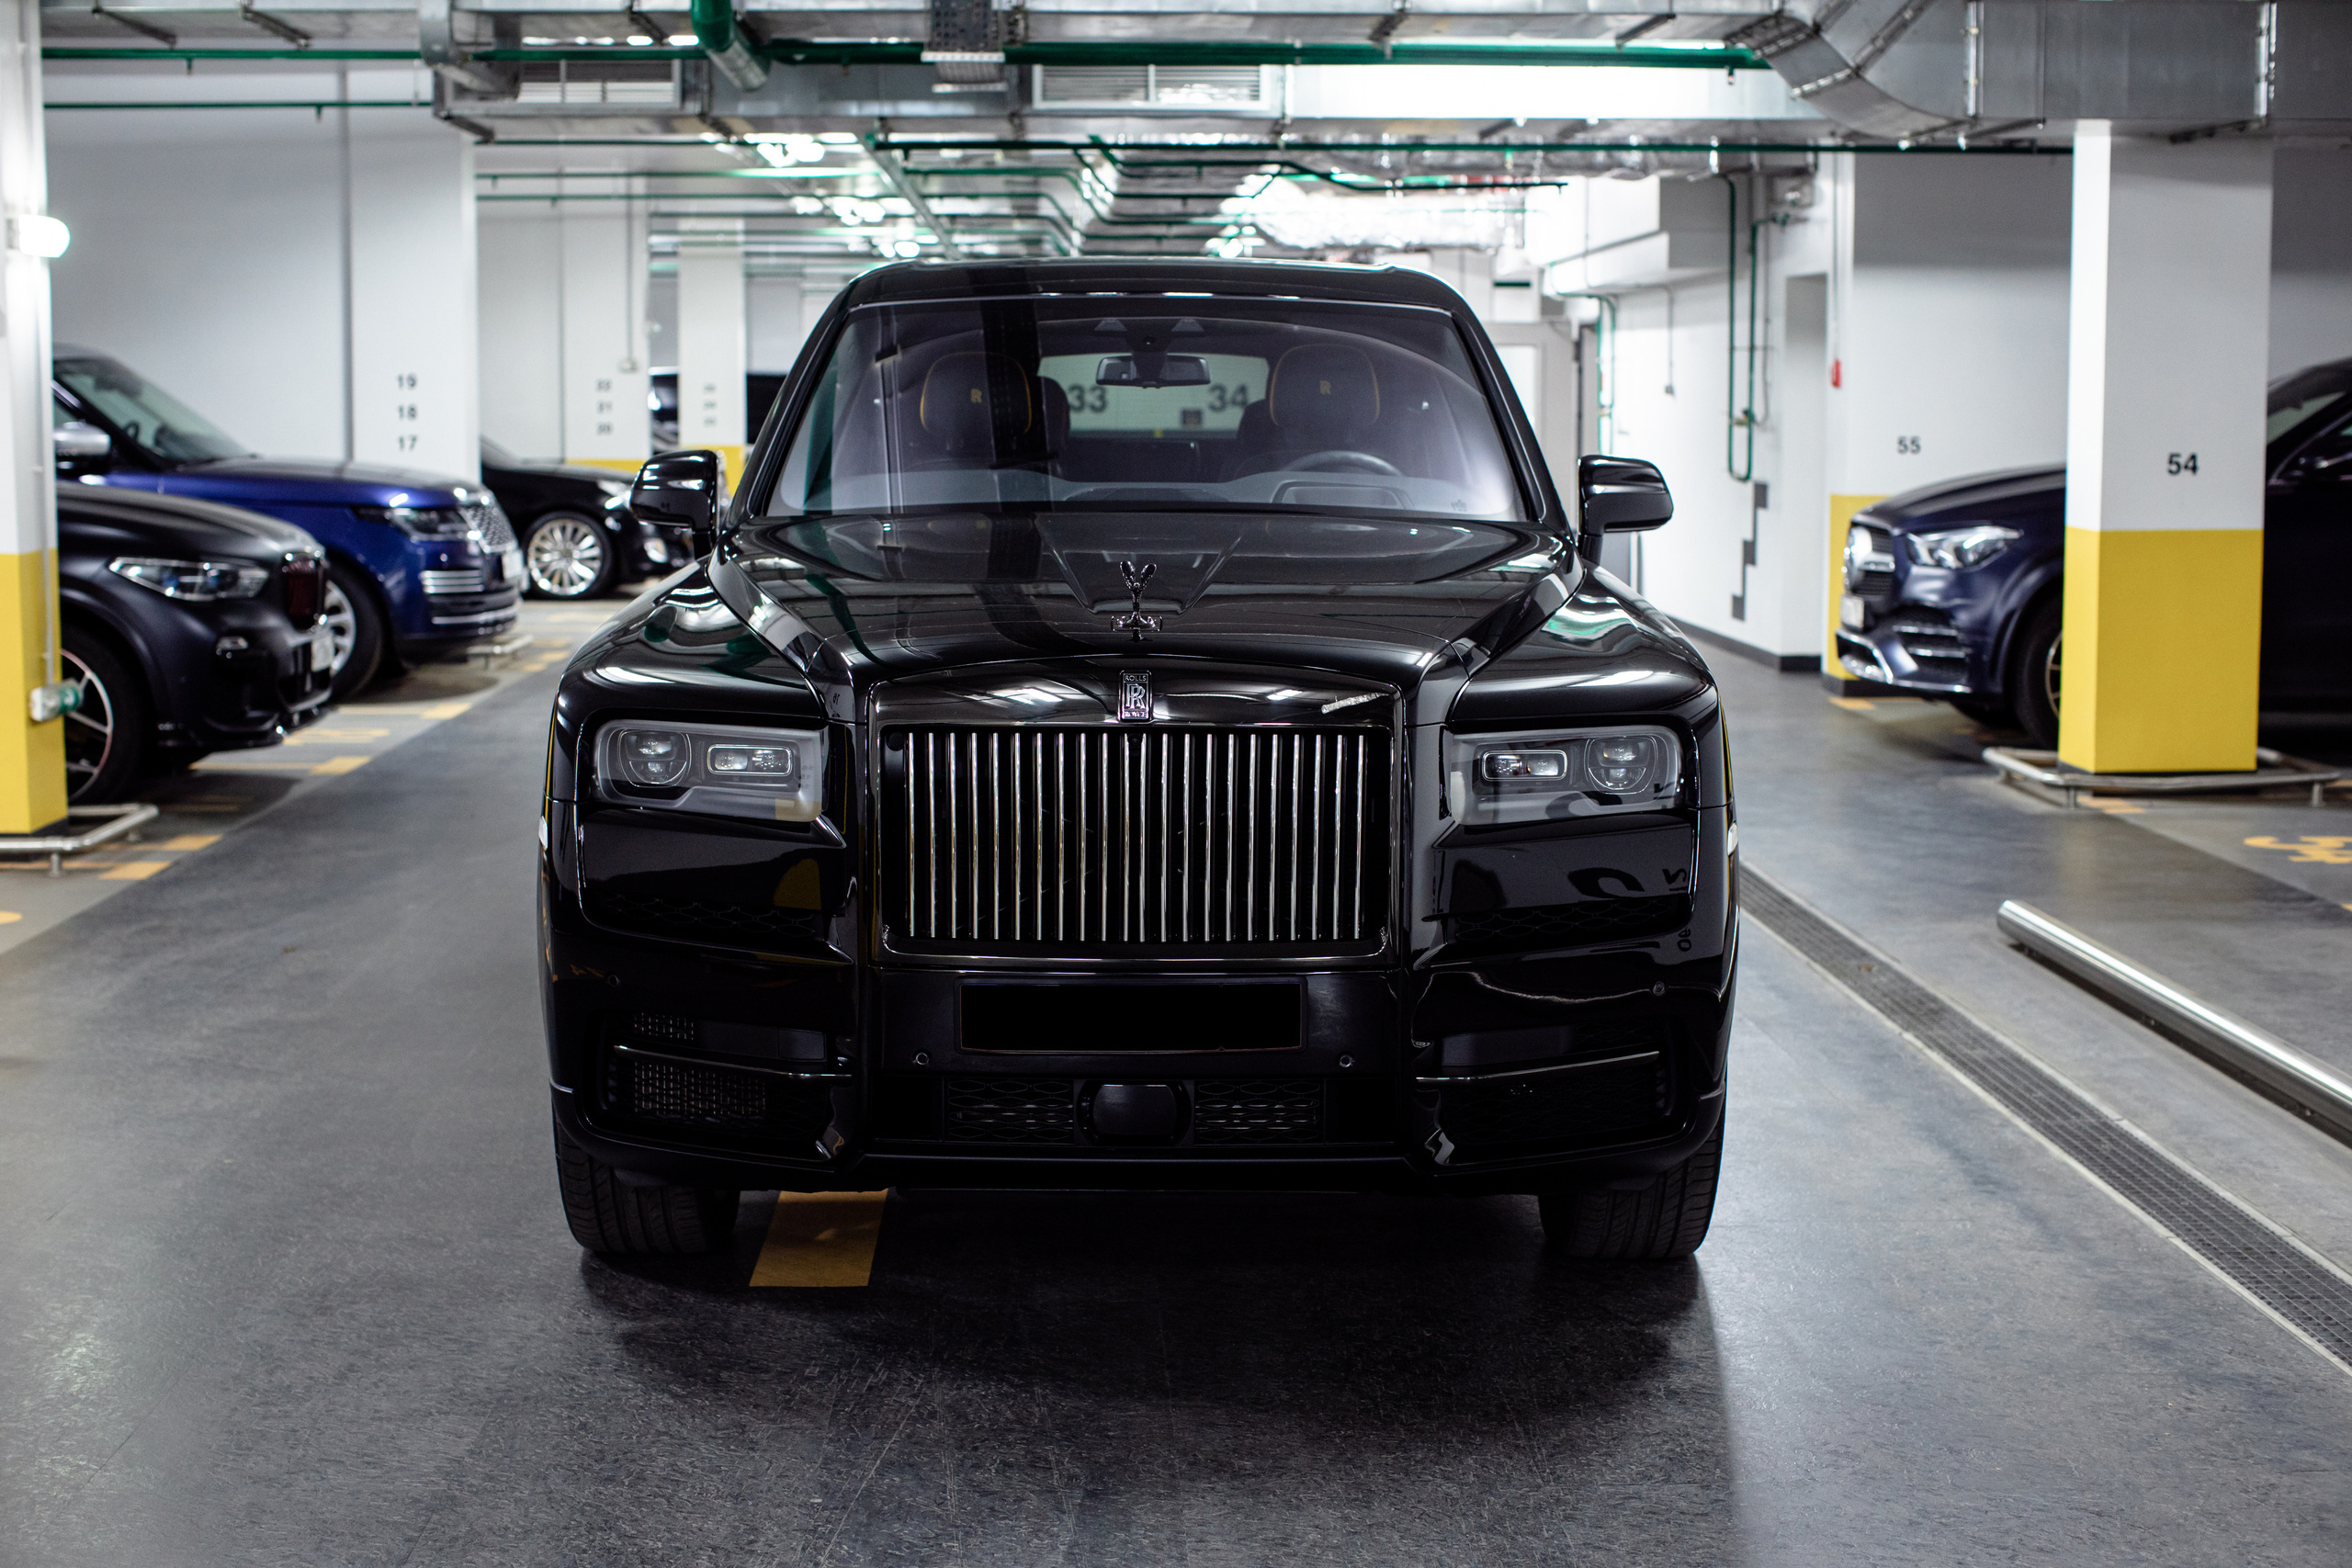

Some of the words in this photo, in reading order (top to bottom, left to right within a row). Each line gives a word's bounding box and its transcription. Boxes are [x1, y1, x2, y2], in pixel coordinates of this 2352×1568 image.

[397, 372, 416, 389] 19
[1068, 383, 1108, 412] 33
[1207, 383, 1249, 412] 34
[398, 434, 418, 451] 17
[1896, 435, 1921, 455] 55
[2168, 452, 2199, 476] 54
